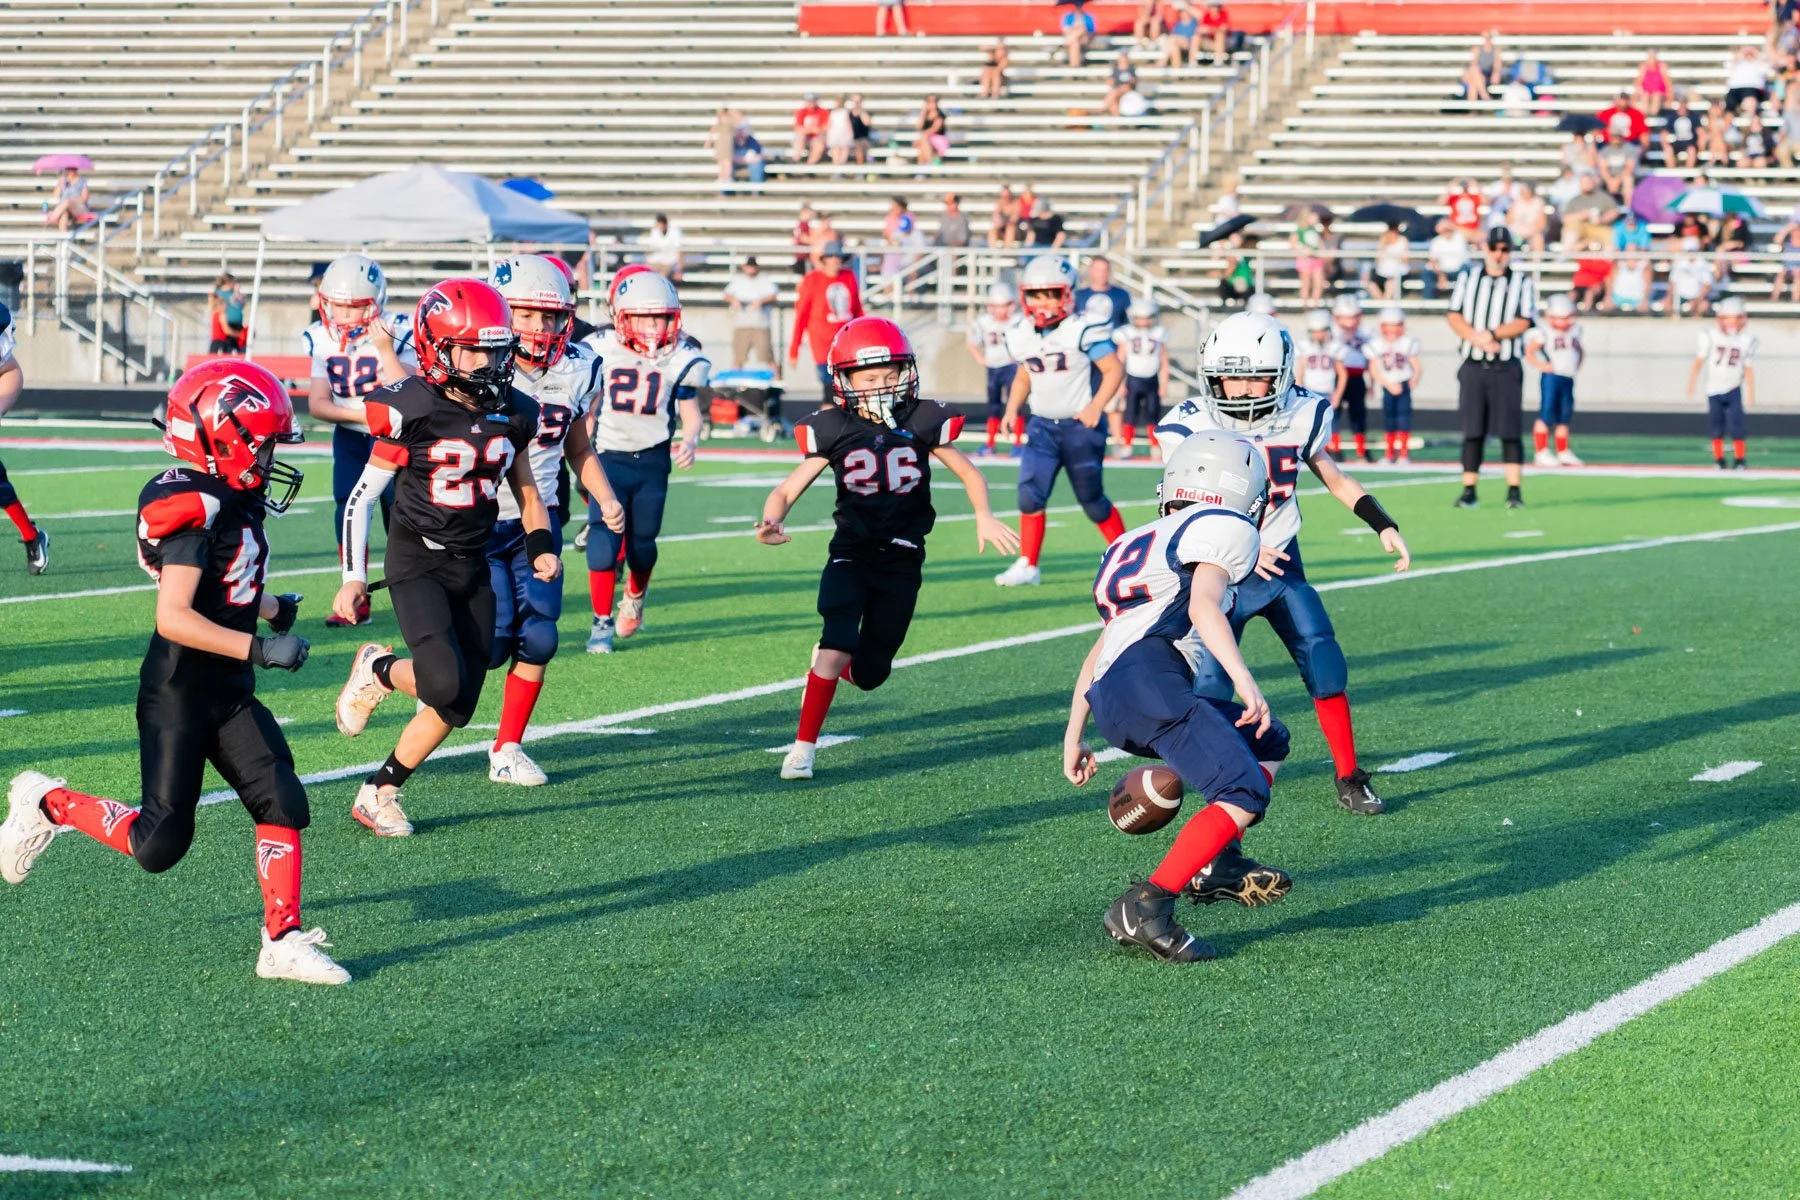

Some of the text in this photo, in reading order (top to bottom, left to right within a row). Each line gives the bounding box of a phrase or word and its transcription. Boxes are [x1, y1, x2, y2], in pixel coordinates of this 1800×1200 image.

[486, 328, 506, 336] Riddell
[326, 355, 384, 398] 82
[610, 367, 661, 415] 21
[537, 402, 573, 449] 9
[427, 435, 516, 510] 23
[842, 445, 922, 496] 26
[1265, 444, 1300, 510] 5
[1174, 488, 1224, 506] Riddell
[220, 524, 271, 607] 4
[1093, 529, 1154, 626] 12
